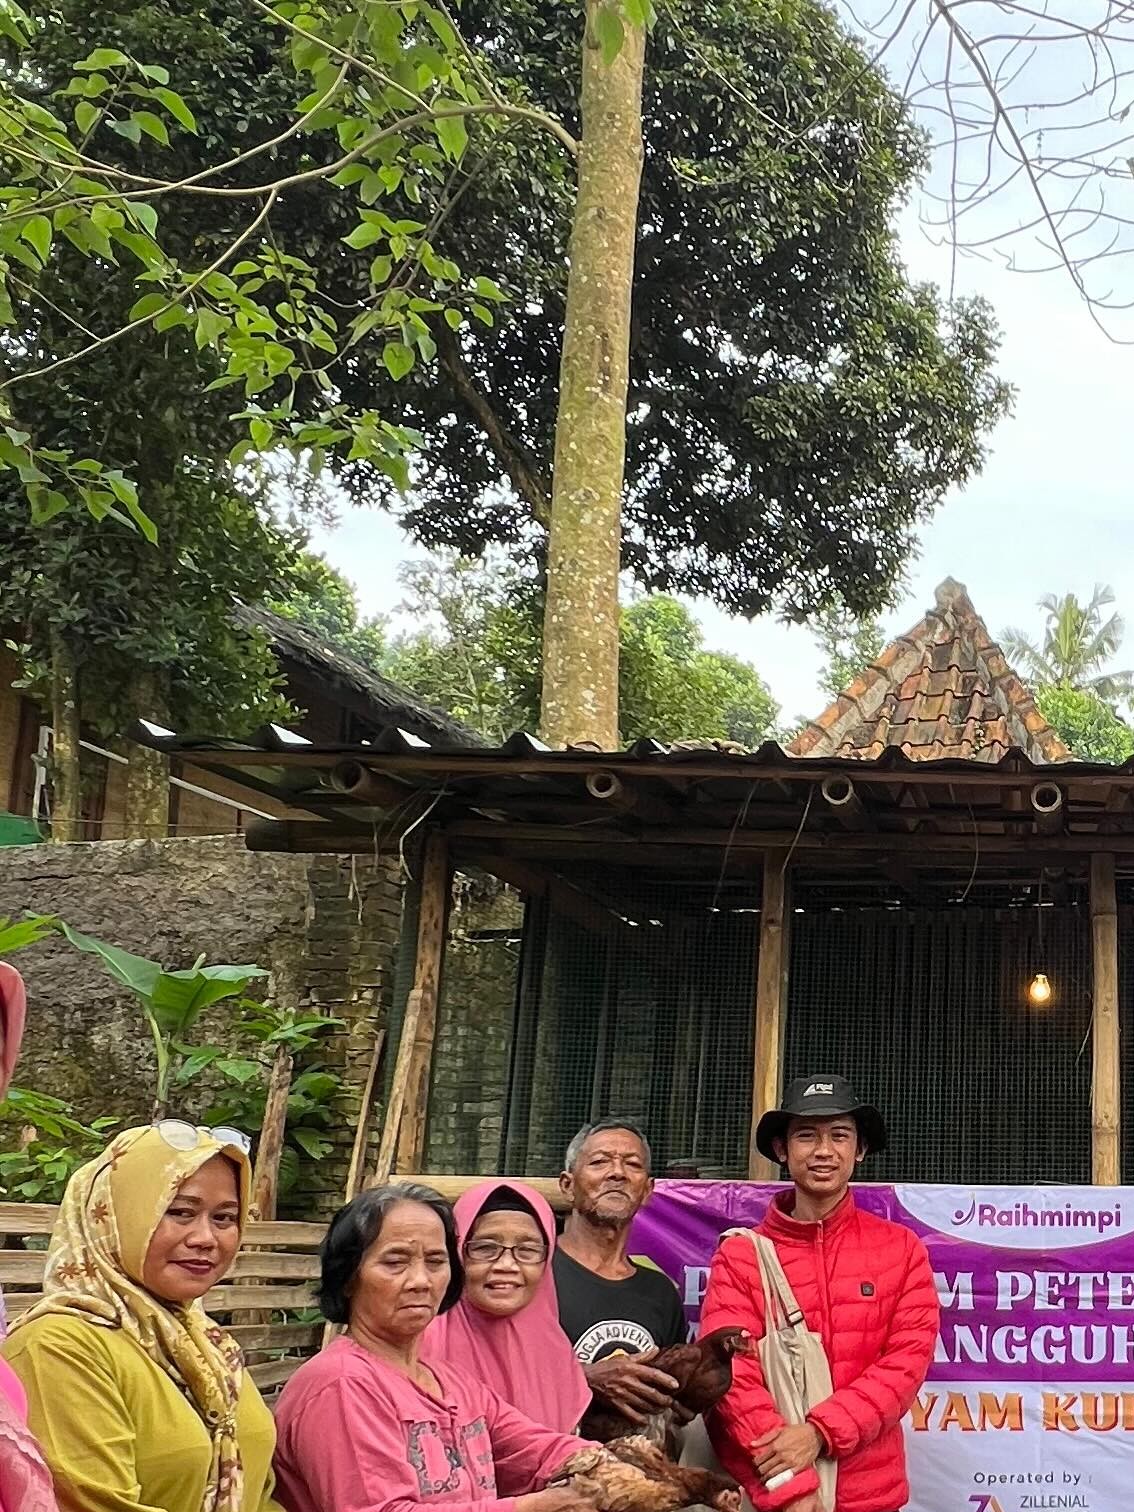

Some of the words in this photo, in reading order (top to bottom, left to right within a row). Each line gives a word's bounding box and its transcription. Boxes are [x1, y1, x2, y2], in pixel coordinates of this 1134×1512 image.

[978, 1203, 1121, 1233] Raihmimpi
[577, 1331, 605, 1360] OGJA
[911, 1391, 1025, 1432] YAM
[973, 1471, 1054, 1486] Operated
[1063, 1470, 1081, 1486] by
[1020, 1495, 1089, 1509] ZILLENIAL
